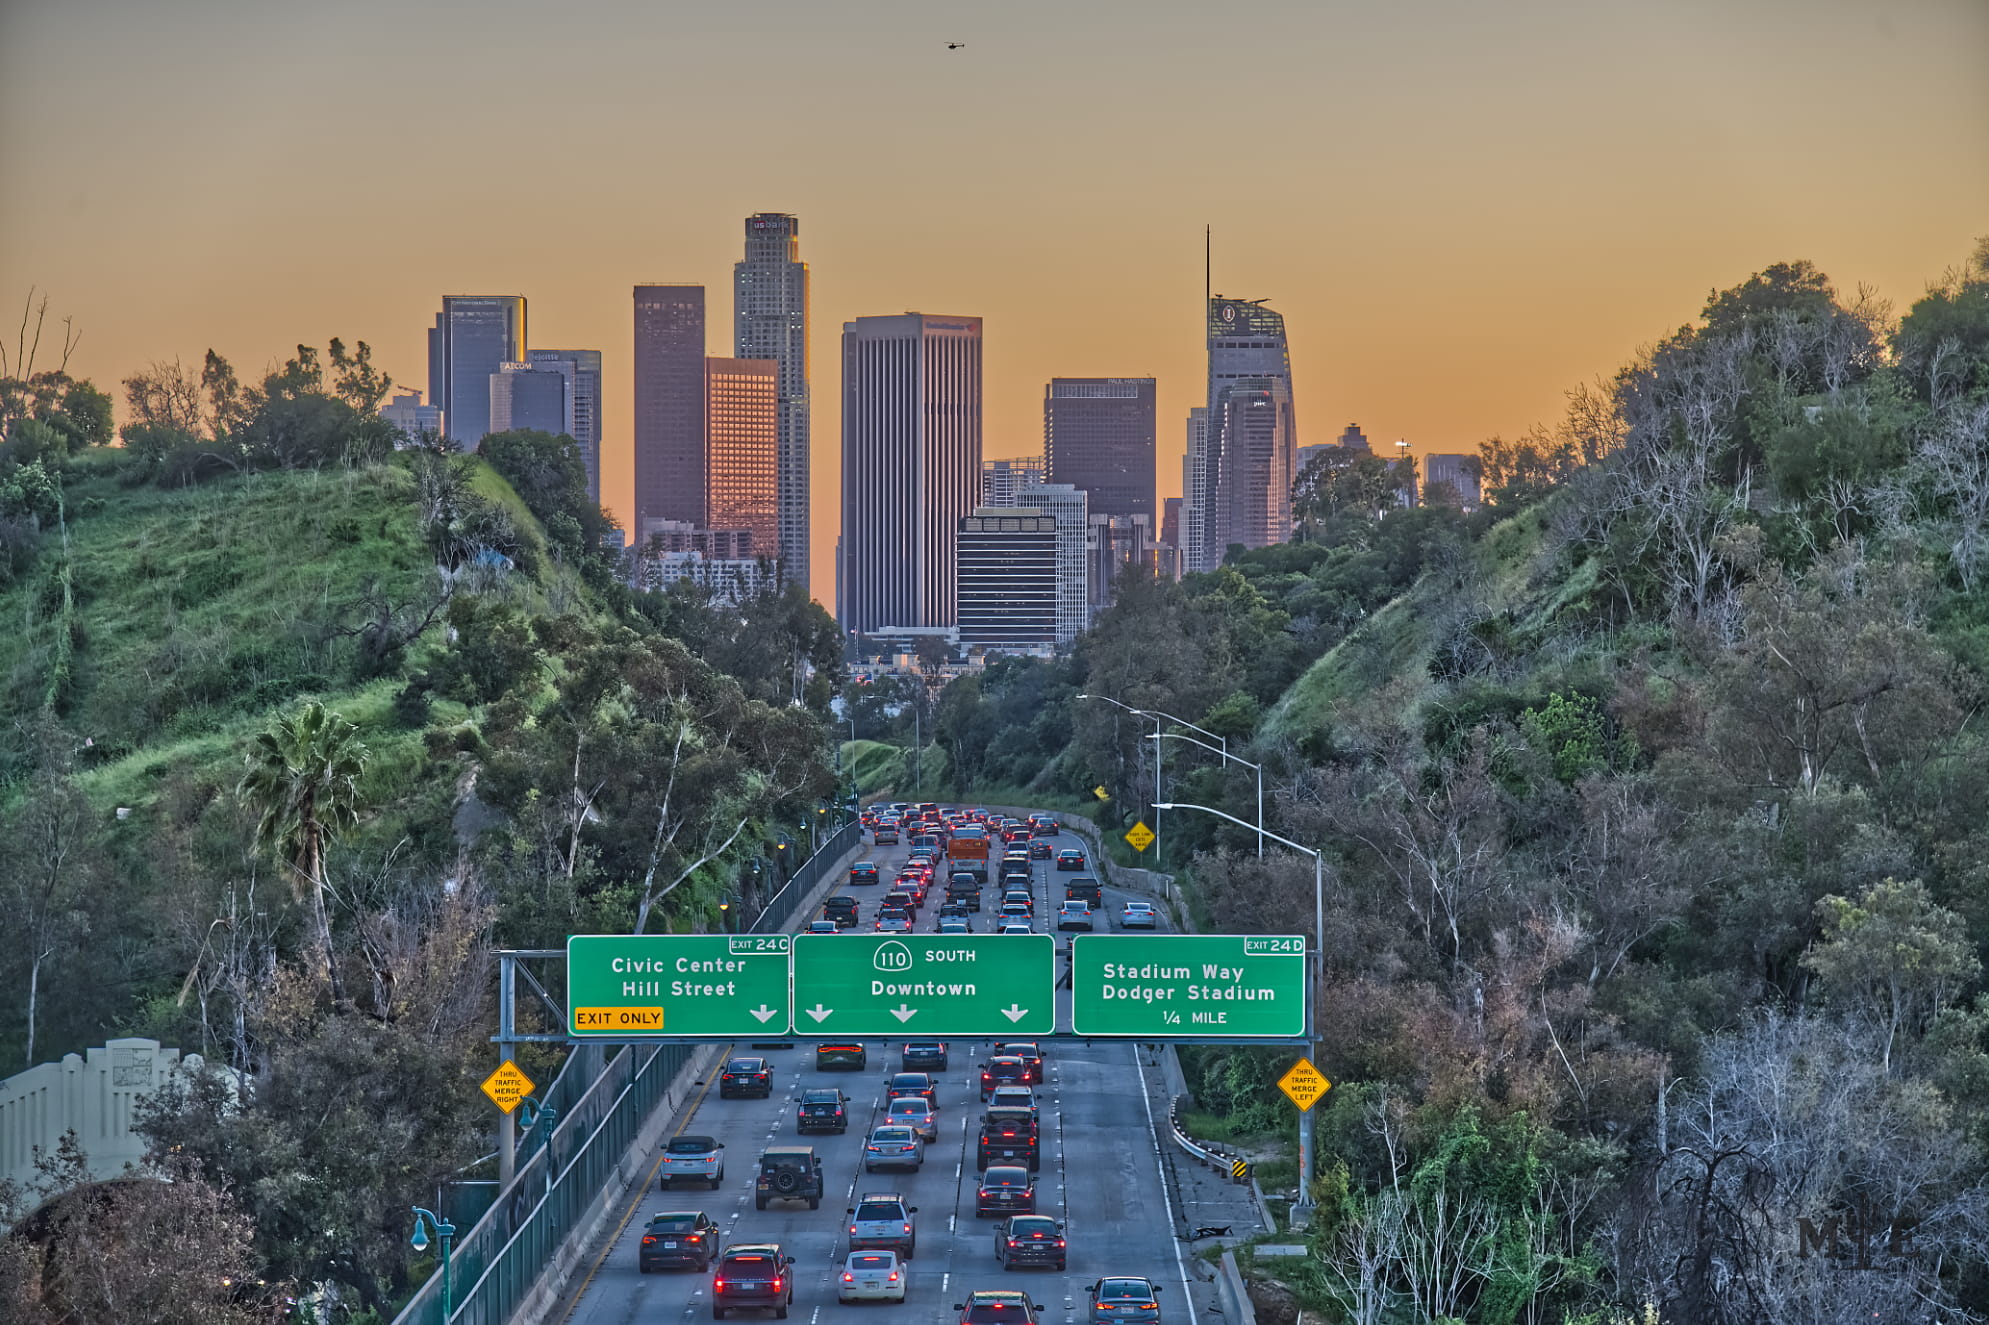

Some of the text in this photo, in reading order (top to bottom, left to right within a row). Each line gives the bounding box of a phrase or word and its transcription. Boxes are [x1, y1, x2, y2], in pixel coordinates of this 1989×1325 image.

[731, 940, 752, 949] EXIT
[1246, 940, 1268, 950] EXIT
[881, 952, 906, 967] 110
[925, 950, 976, 962] SOUTH
[611, 957, 746, 973] Civic Center
[1103, 963, 1244, 983] Stadium Way
[622, 980, 735, 996] Hill Street
[871, 980, 976, 996] Downtown
[1102, 984, 1275, 1004] Dodger Stadium
[577, 1012, 661, 1025] EXIT ONLY
[1192, 1012, 1227, 1024] MILE
